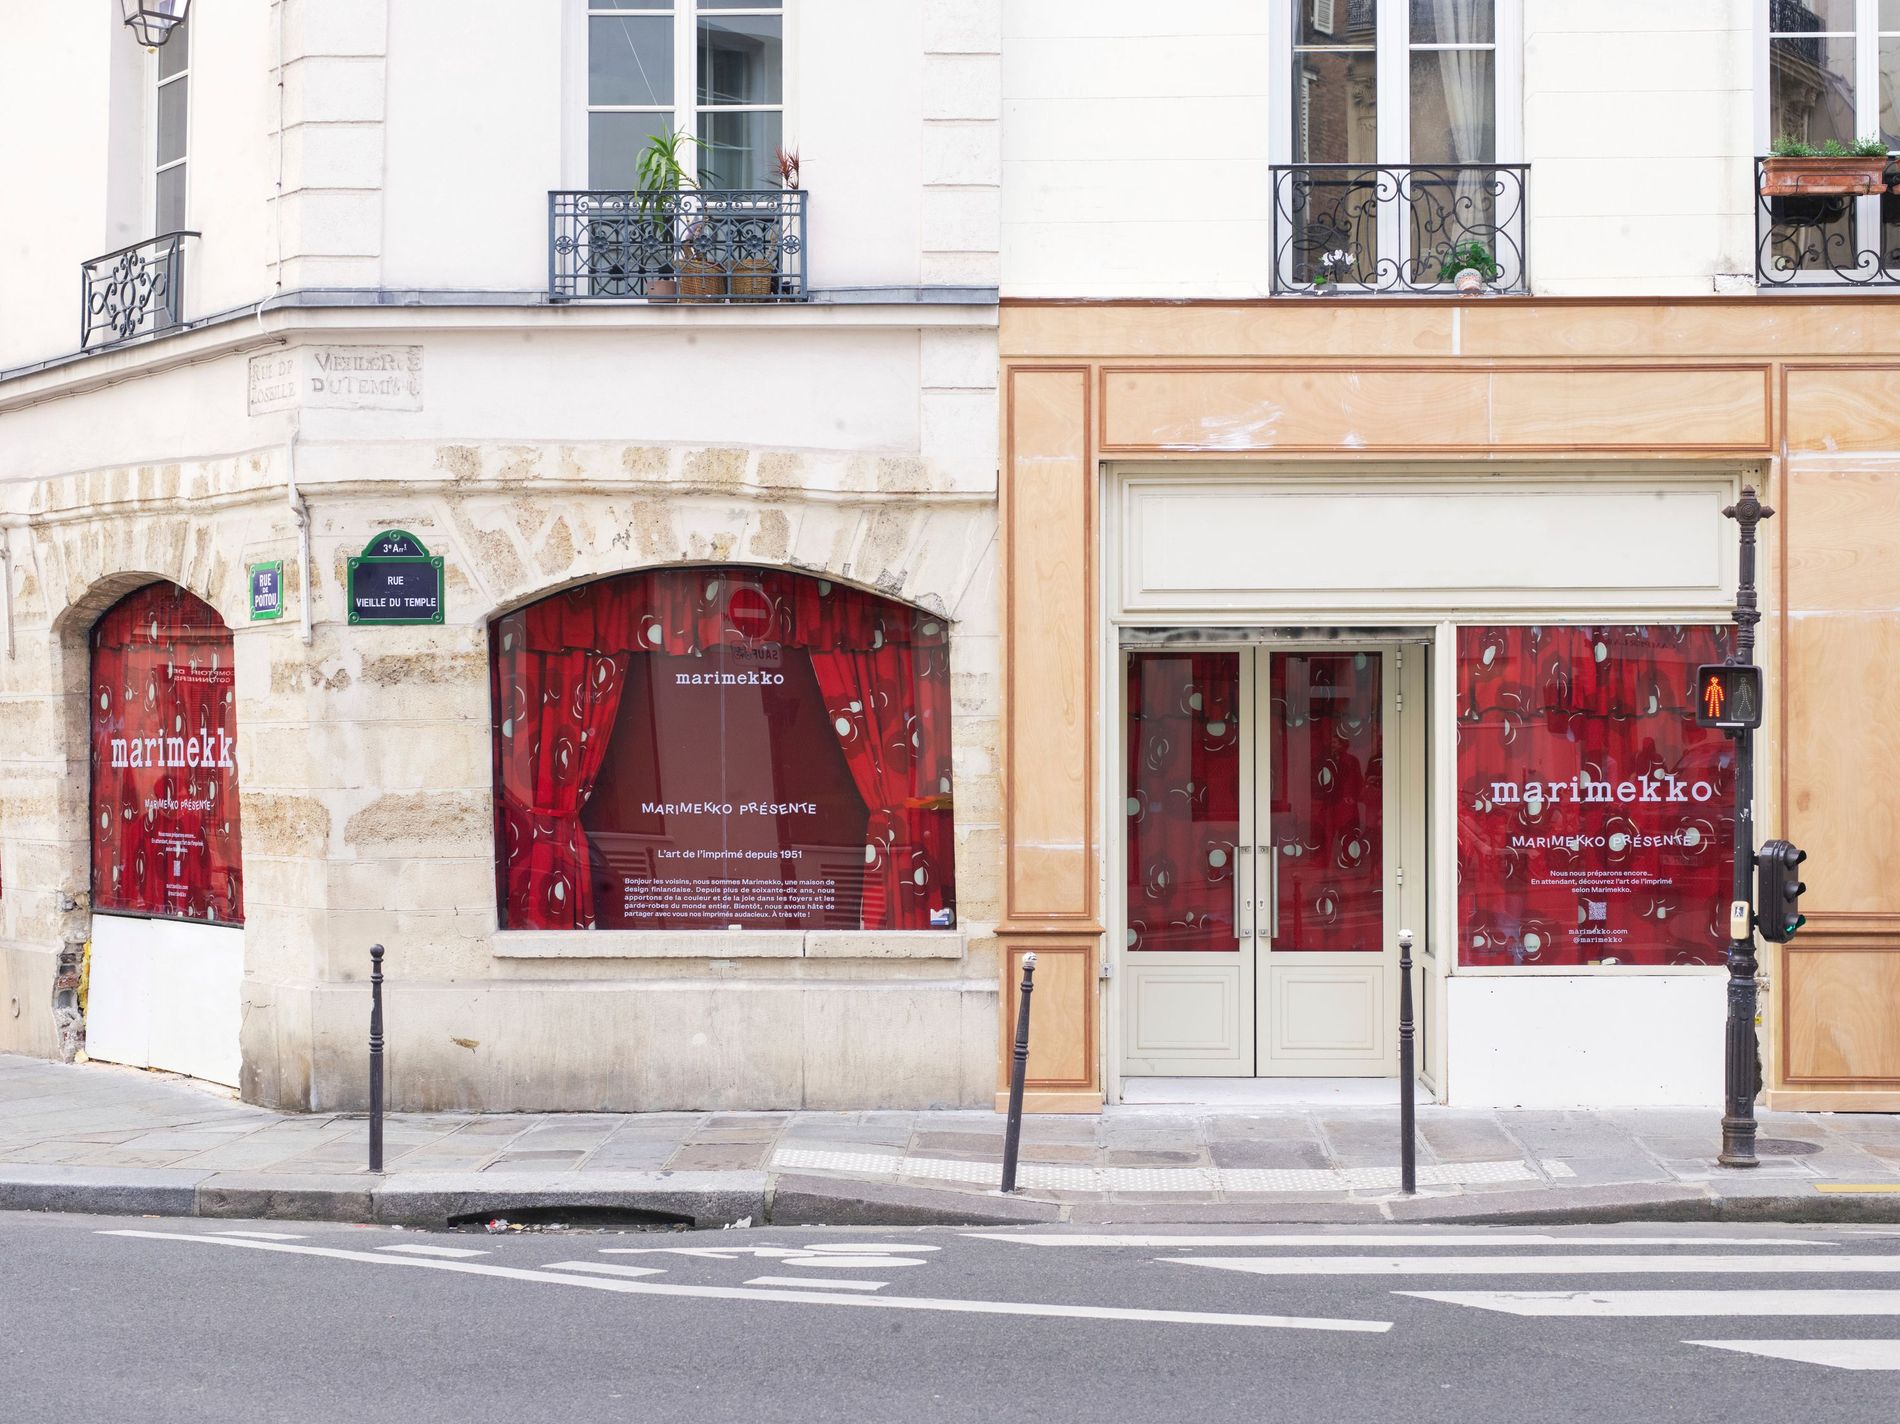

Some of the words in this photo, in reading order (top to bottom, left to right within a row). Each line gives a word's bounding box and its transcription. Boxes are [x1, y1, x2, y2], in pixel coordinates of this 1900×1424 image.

[259, 574, 272, 586] RUE
[388, 576, 404, 584] RUE
[255, 592, 276, 607] POITOU
[356, 598, 386, 606] VIEILLE
[390, 598, 400, 606] DU
[404, 598, 436, 606] TEMPLE
[676, 672, 784, 685] marimekko
[111, 728, 236, 768] marimekk
[1490, 776, 1713, 802] marimekko
[144, 798, 178, 810] MARIMEKKO
[181, 798, 211, 811] PRÉSENTE
[642, 802, 733, 814] MARIMEKKO
[739, 802, 817, 815] PRÉSENTE
[1512, 834, 1606, 848] MARIMEKKO
[1612, 834, 1693, 848] PRÉSENTE
[682, 850, 696, 858] de
[744, 850, 778, 860] depuis
[780, 850, 802, 858] 1951
[1586, 870, 1622, 878] préparons
[624, 878, 652, 886] Bonjour
[664, 878, 692, 886] voisins,
[742, 878, 784, 886] Marimekko,
[624, 886, 648, 894] design
[722, 886, 738, 894] plus
[742, 894, 756, 902] joie
[734, 902, 762, 910] Bientôt,
[702, 910, 734, 918] imprimés
[1568, 926, 1628, 934] marimekko.com
